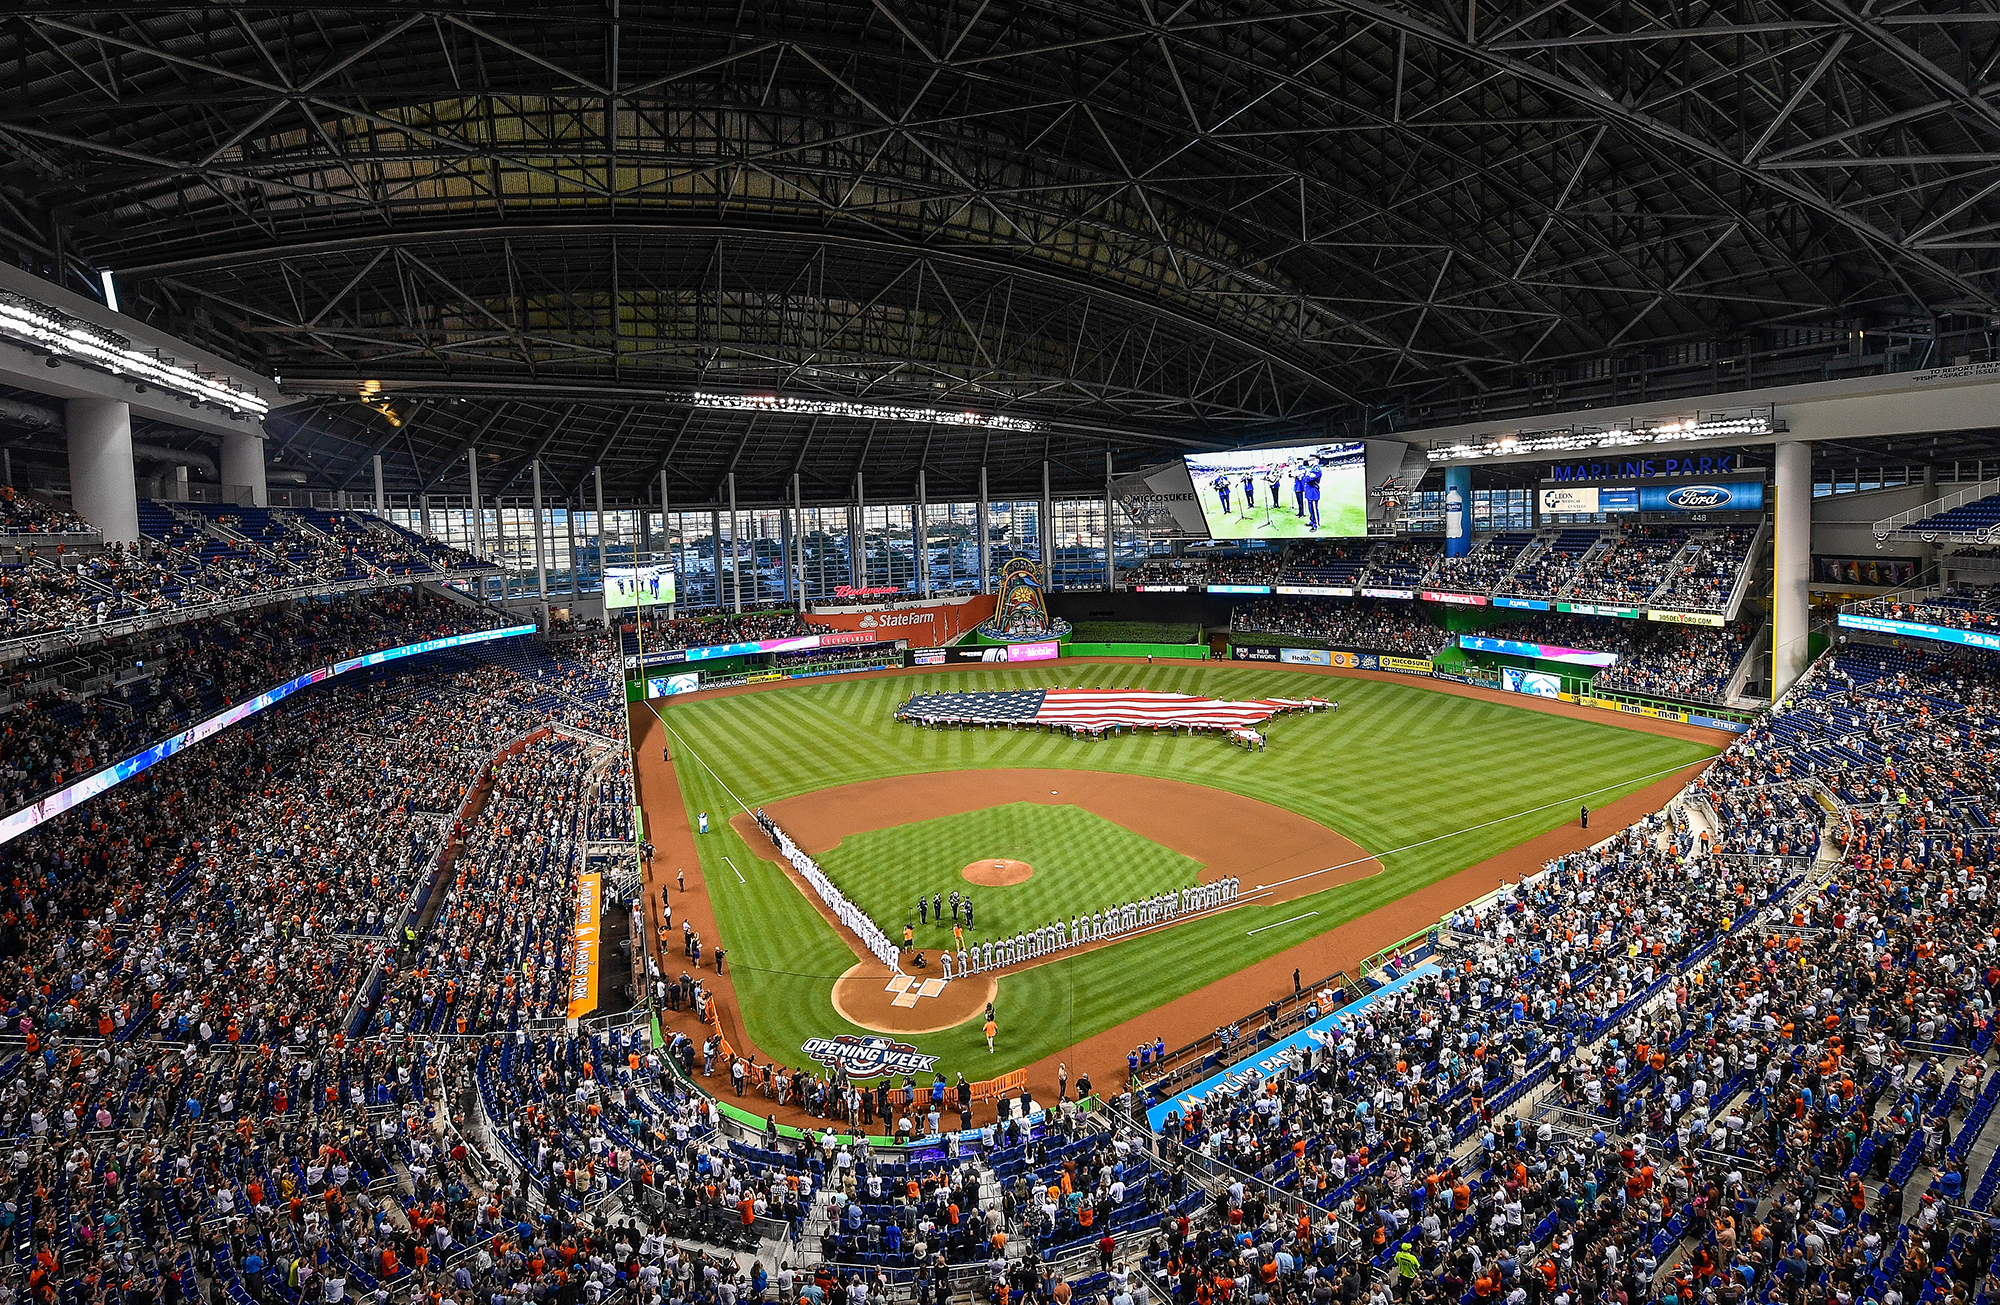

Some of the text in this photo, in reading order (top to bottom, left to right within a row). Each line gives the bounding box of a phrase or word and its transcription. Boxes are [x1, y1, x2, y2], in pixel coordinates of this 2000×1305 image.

[1555, 456, 1734, 482] MARLINS PARK
[1133, 493, 1194, 502] MICCOSUKEE
[1678, 488, 1718, 505] Ford
[834, 585, 898, 597] Budweiser
[1963, 633, 2000, 647] 7:26 PM
[1392, 658, 1430, 667] MICCOSUKEE
[579, 908, 591, 925] PARK
[572, 940, 596, 1001] MARLINS PARK
[804, 1040, 934, 1070] OPENING WEEK
